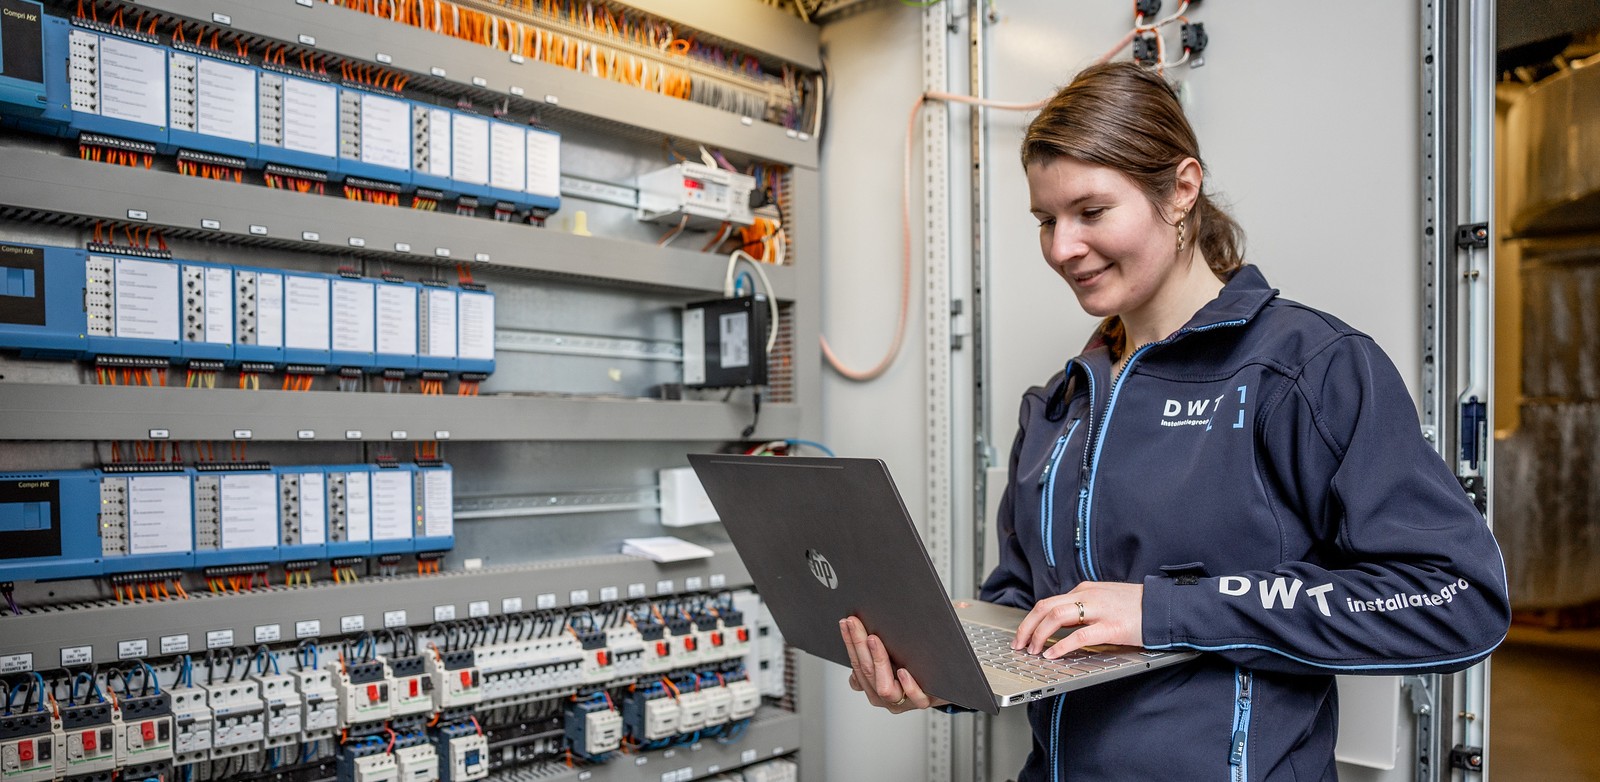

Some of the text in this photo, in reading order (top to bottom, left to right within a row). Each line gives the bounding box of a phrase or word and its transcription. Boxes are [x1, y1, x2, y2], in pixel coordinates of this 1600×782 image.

[3, 8, 37, 22] Compri HX
[1, 246, 23, 254] Compri
[18, 481, 39, 489] Compri
[809, 549, 837, 590] hp
[1219, 576, 1334, 617] DWT
[1346, 578, 1470, 613] installaiegro
